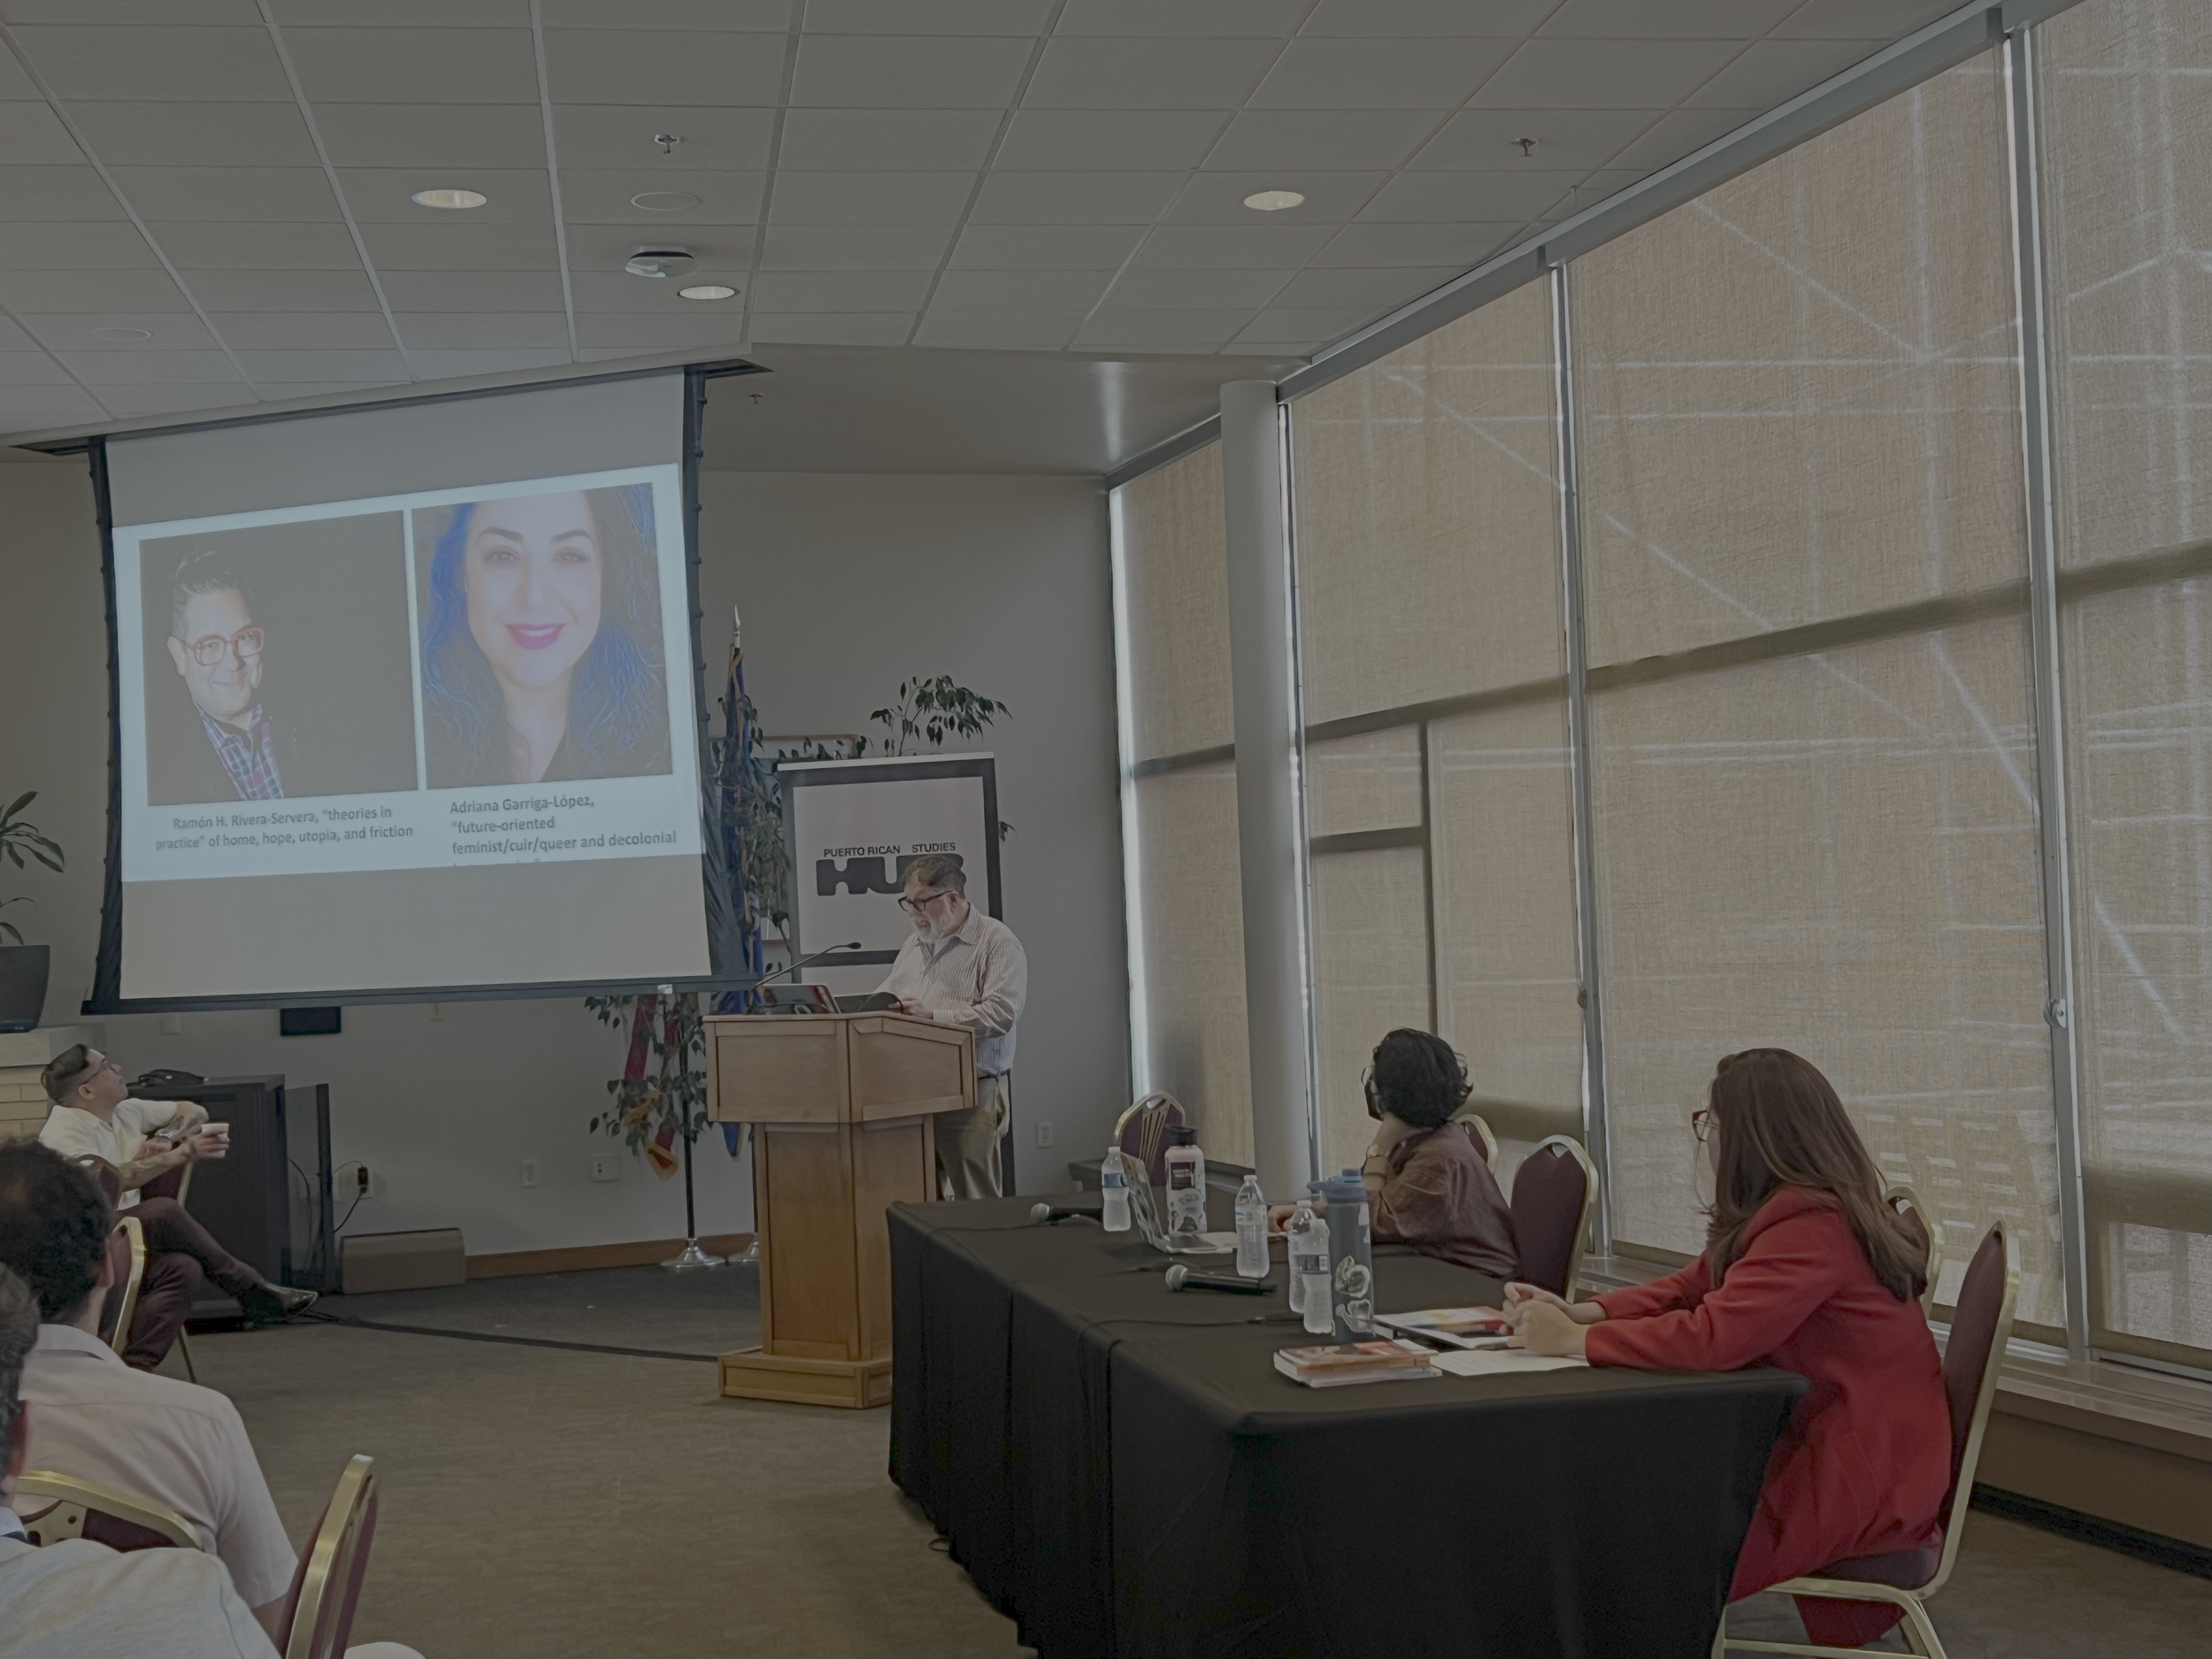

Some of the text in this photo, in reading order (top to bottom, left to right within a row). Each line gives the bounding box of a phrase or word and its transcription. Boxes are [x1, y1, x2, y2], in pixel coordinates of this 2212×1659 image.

[450, 795, 595, 814] Adriana Garriga-López,
[173, 806, 391, 830] Ramón H. Rivera-Servera, “theories in
[451, 816, 555, 833] “future-oriented
[156, 825, 413, 851] practice” of home, hope, utopia, and friction
[452, 830, 677, 855] feminist/cuir/queer and decolonial
[824, 842, 956, 857] PUERTO RICAN STUDIES
